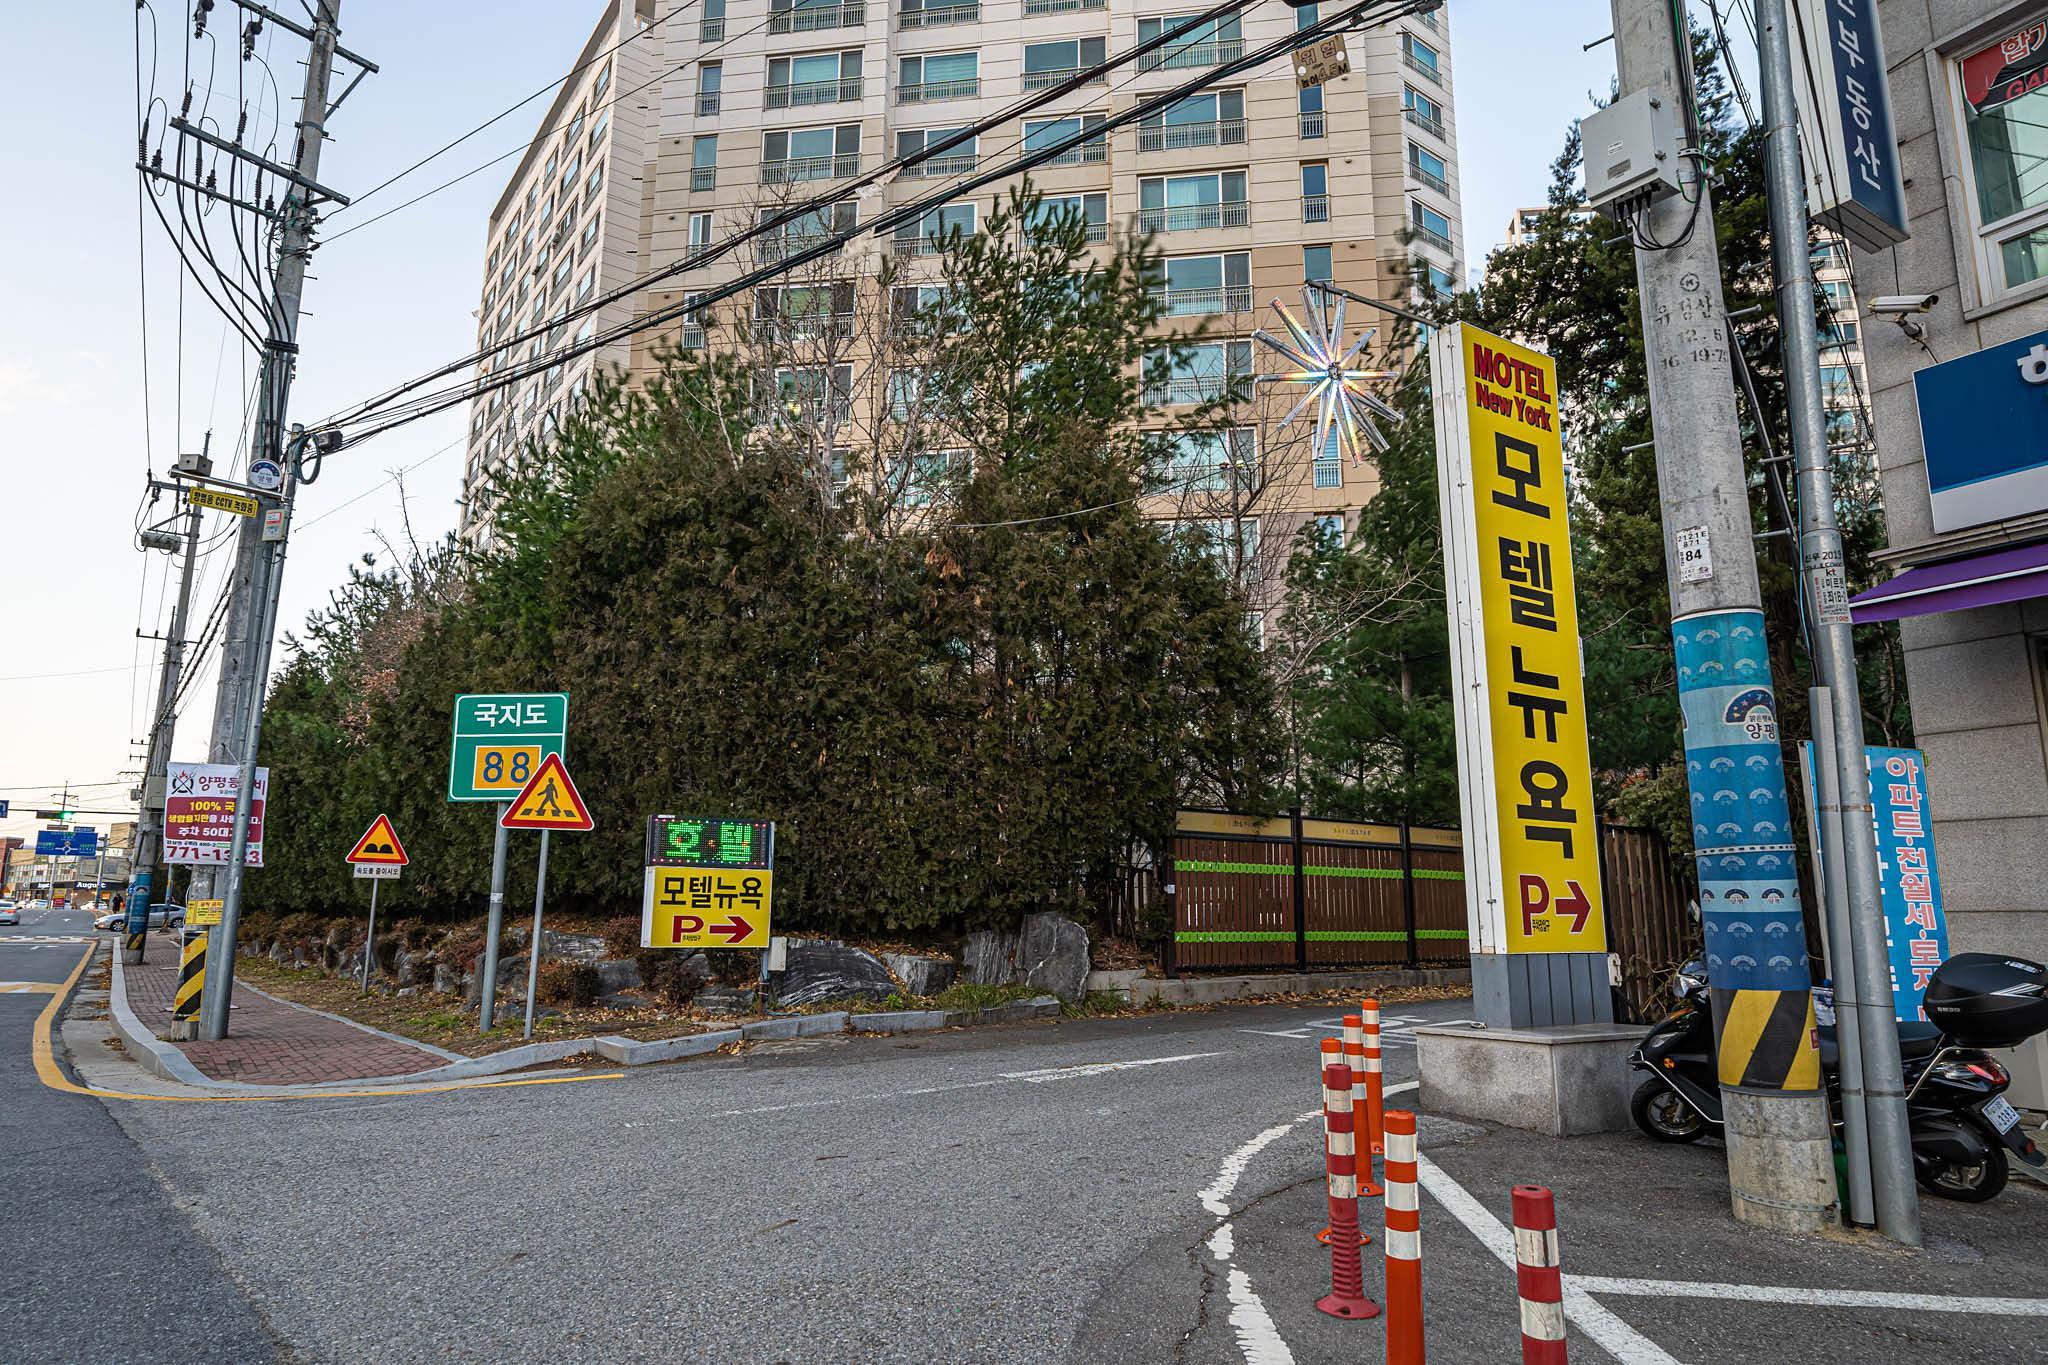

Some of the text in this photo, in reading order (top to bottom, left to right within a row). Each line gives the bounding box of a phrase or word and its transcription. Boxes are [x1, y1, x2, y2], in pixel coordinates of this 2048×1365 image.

[1473, 343, 1551, 404] MOTEL
[1475, 382, 1552, 432] New York
[215, 497, 233, 509] CCTV
[1685, 549, 1702, 562] 84
[1825, 568, 1837, 577] kt
[474, 702, 548, 727] 국지도
[1746, 723, 1775, 739] 양평
[483, 752, 530, 783] 88
[190, 801, 221, 811] 100%
[178, 826, 200, 837] 주차
[77, 881, 107, 890] Augut
[660, 876, 764, 910] 모텔뉴욕
[1519, 873, 1550, 936] P
[671, 915, 705, 944] P
